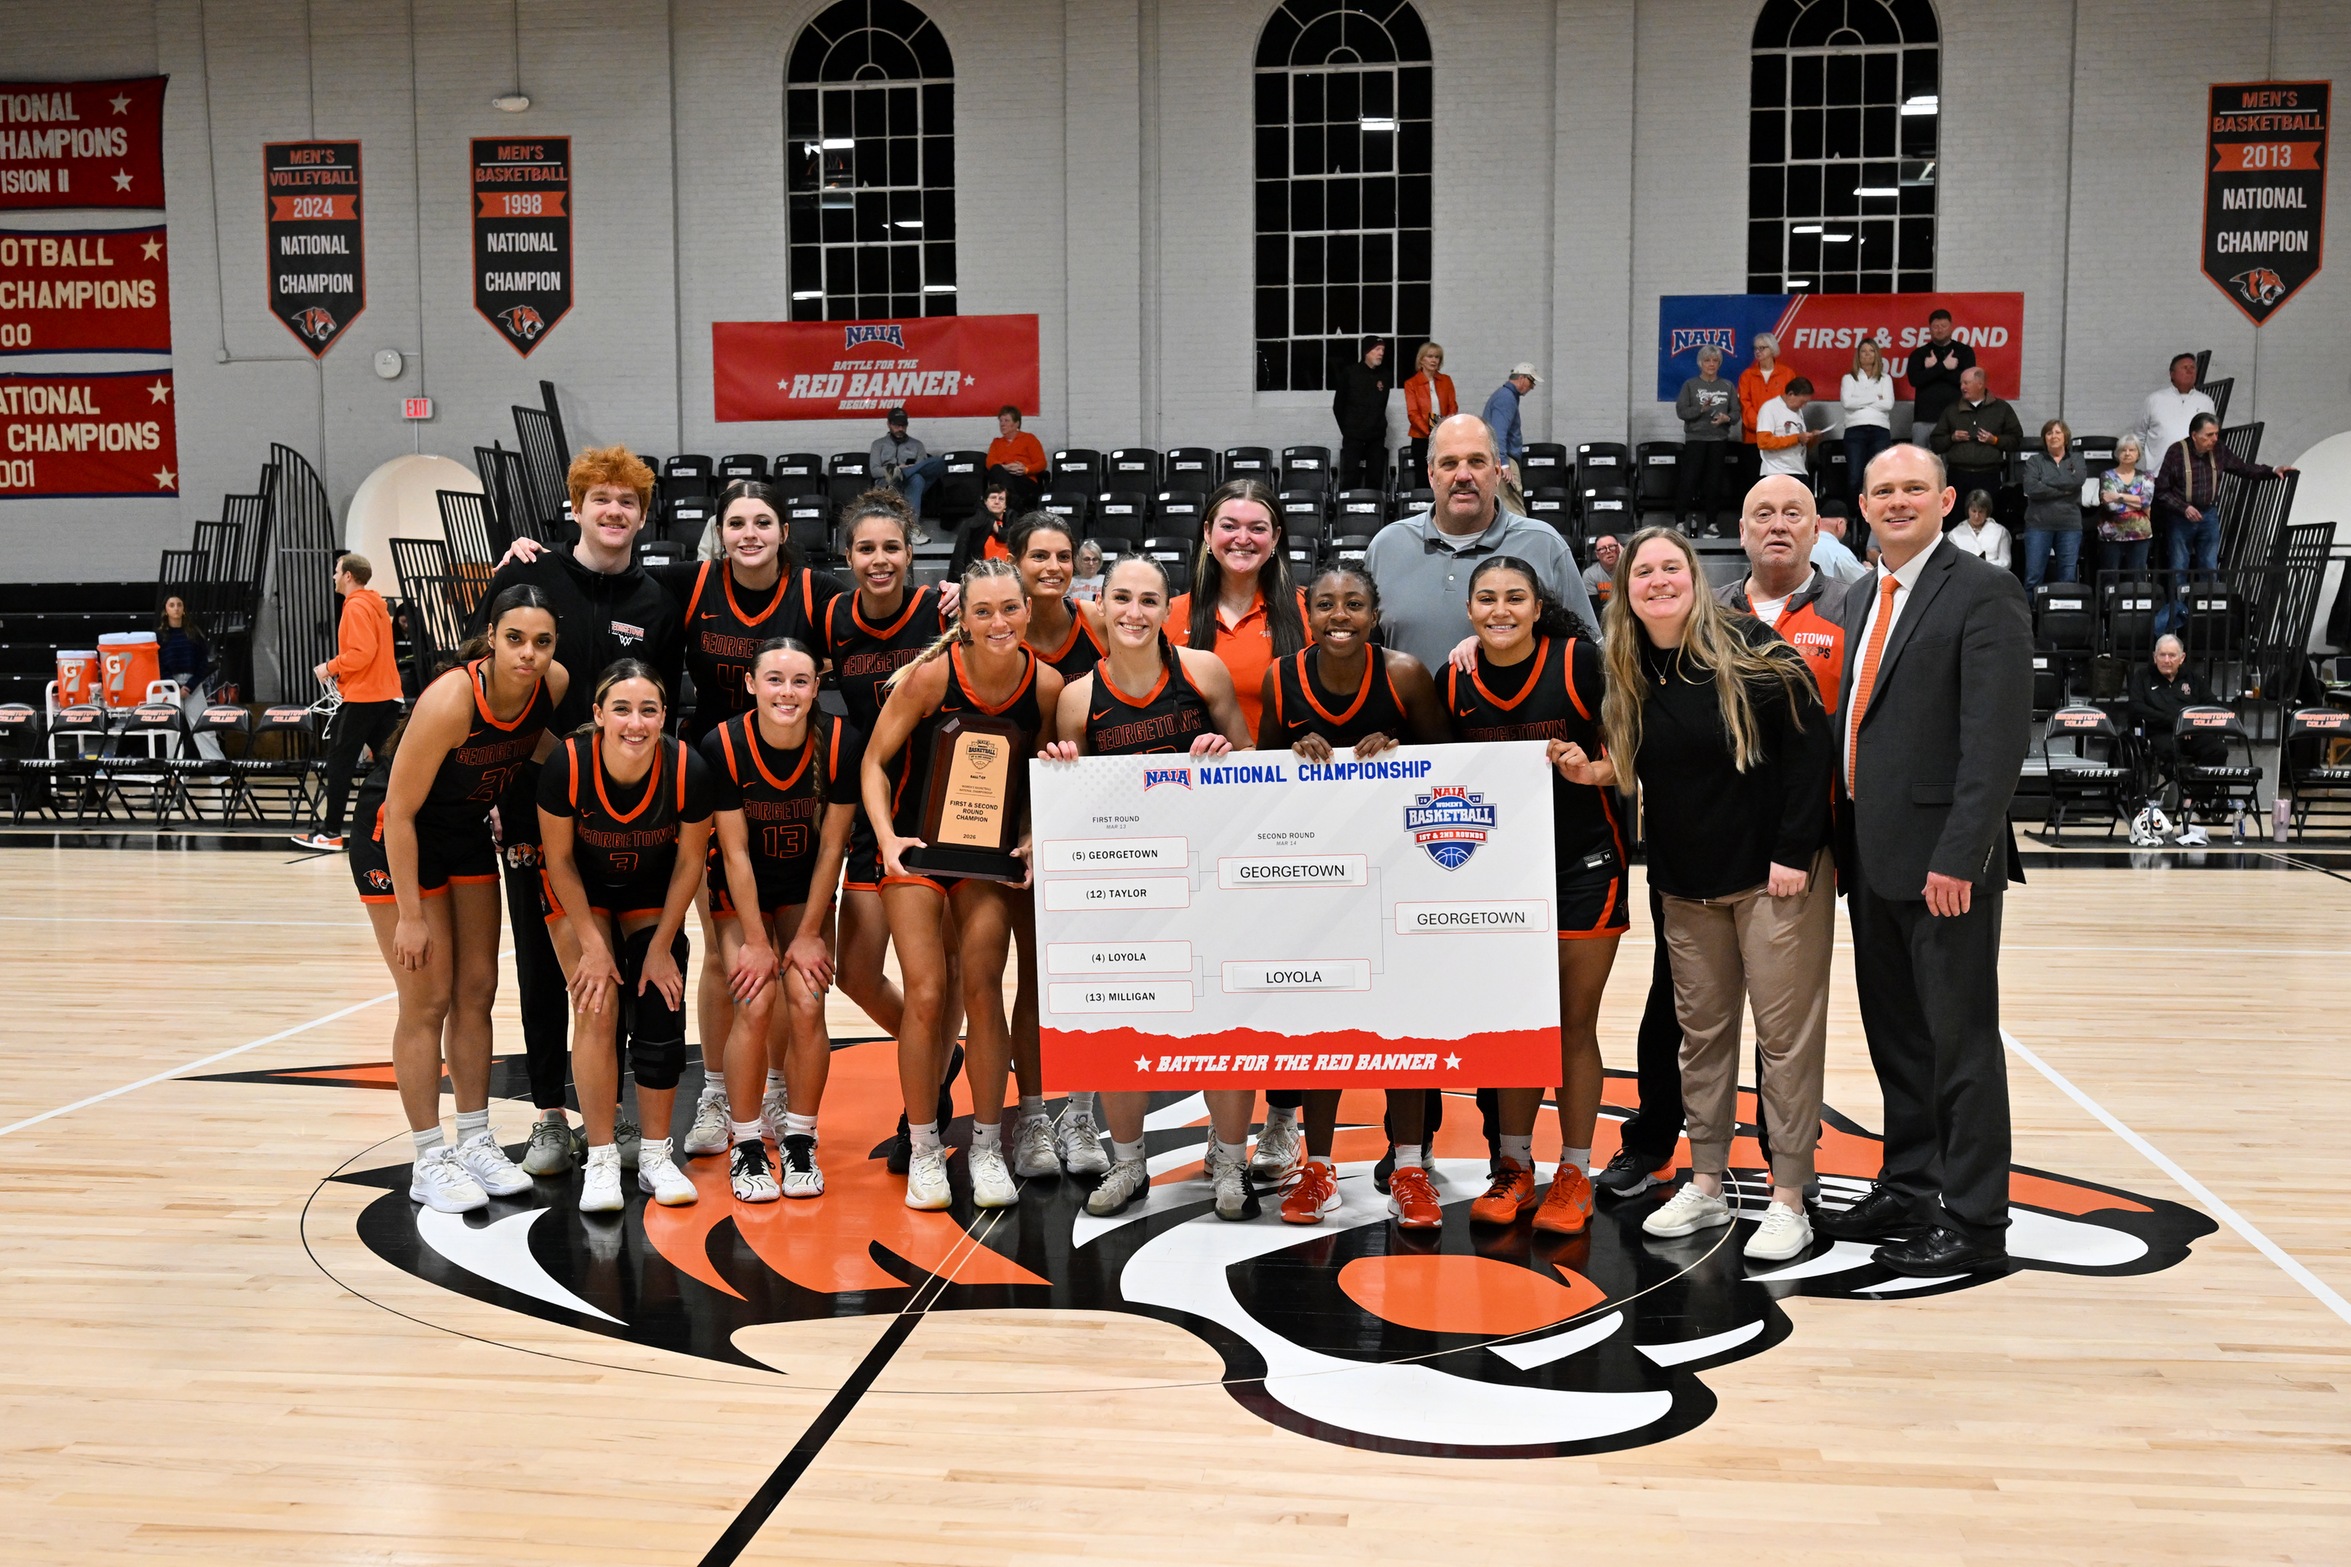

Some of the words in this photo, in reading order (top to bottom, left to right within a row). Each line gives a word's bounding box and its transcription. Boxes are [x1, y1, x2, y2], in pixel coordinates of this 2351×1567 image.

[2242, 91, 2298, 108] MEN'S
[2213, 114, 2325, 133] BASKETBALL
[0, 127, 128, 160] HAMPIONS
[497, 145, 544, 160] MEN'S
[290, 150, 335, 164] MEN'S
[2242, 144, 2292, 168] 2013
[1, 169, 50, 194] ISION
[269, 171, 358, 186] VOLLEYBALL
[475, 167, 568, 183] BASKETBALL
[293, 197, 334, 218] 2024
[502, 194, 543, 215] 1998
[2222, 187, 2307, 210] NATIONAL
[281, 235, 350, 255] NATIONAL
[487, 232, 558, 252] NATIONAL
[2217, 230, 2309, 253] CHAMPION
[1, 238, 114, 267] OTBALL
[279, 273, 354, 294] CHAMPION
[485, 271, 561, 292] CHAMPION
[0, 279, 157, 310] CHAMPIONS
[845, 325, 905, 351] NAIA
[1672, 328, 1735, 357] NAIA
[1793, 327, 1868, 349] FIRST
[1873, 327, 1892, 348] &
[1899, 326, 2008, 348] SEOND
[832, 360, 873, 371] BATTLE
[874, 360, 895, 370] FOR
[897, 359, 919, 369] THE
[789, 373, 845, 399] RED
[846, 371, 961, 398] BANNER
[406, 399, 428, 417] EXIT
[838, 399, 877, 410] BEGINS
[878, 398, 907, 410] NOW
[7, 421, 160, 452] CHAMPIONS
[701, 630, 764, 659] GEORGET
[1793, 632, 1834, 647] GTOWN
[63, 665, 78, 678] G
[106, 655, 121, 674] G
[842, 647, 924, 677] GEORGETO
[717, 663, 751, 710] 4
[1095, 708, 1202, 752] GEORGETOWN
[237, 761, 272, 769] TIGERS
[2077, 770, 2119, 778] TIGERS
[2207, 768, 2250, 776] TIGERS
[1144, 768, 1193, 792] NAIA
[1200, 765, 1287, 785] NATIONAL
[1298, 760, 1432, 782] CHAMPIONSHIP
[1433, 787, 1466, 800] NAIA
[743, 797, 819, 821] EORGETO
[956, 814, 988, 823] CHAMPION
[962, 808, 984, 816] ROUND
[1408, 808, 1493, 826] BASKETBALL
[1114, 815, 1140, 823] ROUND
[763, 824, 808, 859] 13
[1257, 832, 1287, 840] SECOND
[1289, 831, 1315, 839] ROUND
[1419, 833, 1431, 841] 1ST
[1456, 831, 1484, 839] ROUNDS
[1072, 850, 1086, 861] (5)
[1089, 849, 1158, 860] GEORGETOWN
[1240, 864, 1345, 878] GEORGETOWN
[1086, 889, 1106, 900] (12)
[1109, 888, 1147, 899] TAYLOR
[1417, 911, 1525, 926] GEORGETOWN
[1091, 953, 1106, 964] (4)
[1108, 952, 1147, 962] LOYOLA
[1266, 971, 1322, 984] LOYOLA
[1085, 992, 1106, 1003] (13)
[1108, 991, 1156, 1002] MILLIGAN
[1156, 1055, 1231, 1072] BATTLE
[1231, 1055, 1269, 1072] FOR
[1274, 1054, 1310, 1071] THE
[1314, 1053, 1353, 1071] RED
[1355, 1053, 1438, 1070] BANNER
